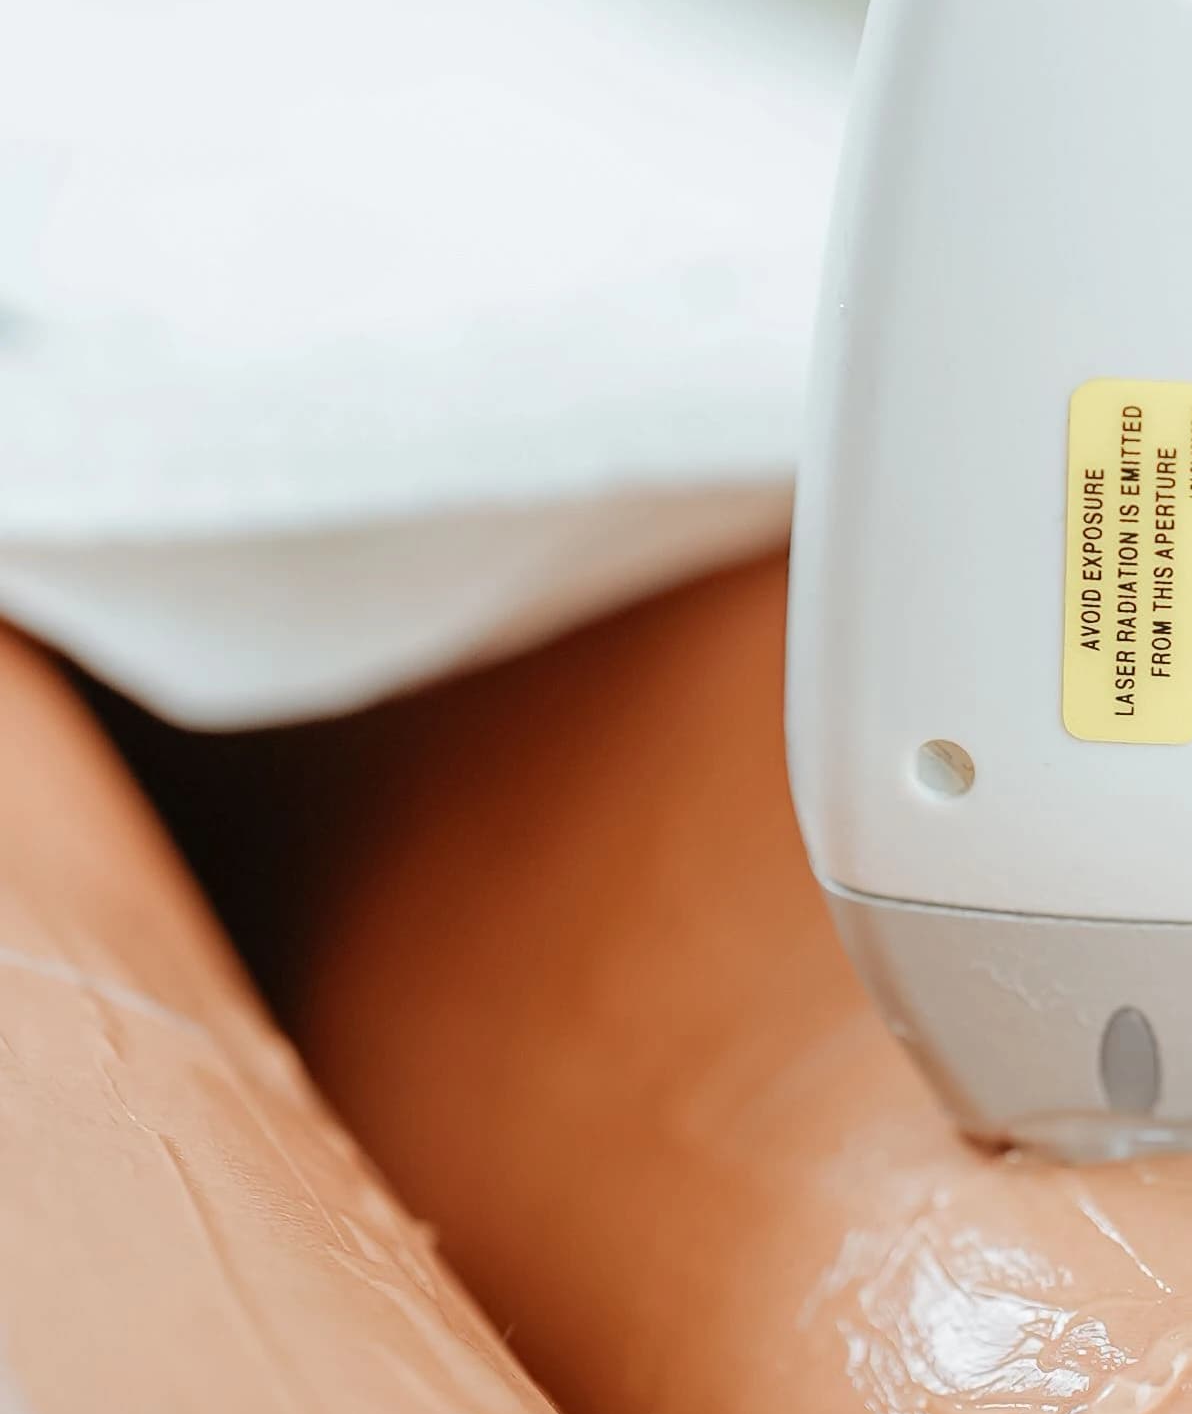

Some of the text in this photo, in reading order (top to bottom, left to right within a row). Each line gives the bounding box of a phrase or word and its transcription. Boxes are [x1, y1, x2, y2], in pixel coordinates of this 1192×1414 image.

[1080, 469, 1104, 651] AVOID EXPOSURE
[1114, 406, 1142, 716] LASER RADIATION IS EMITTED
[1151, 448, 1177, 677] FROM THIS APERTURE
